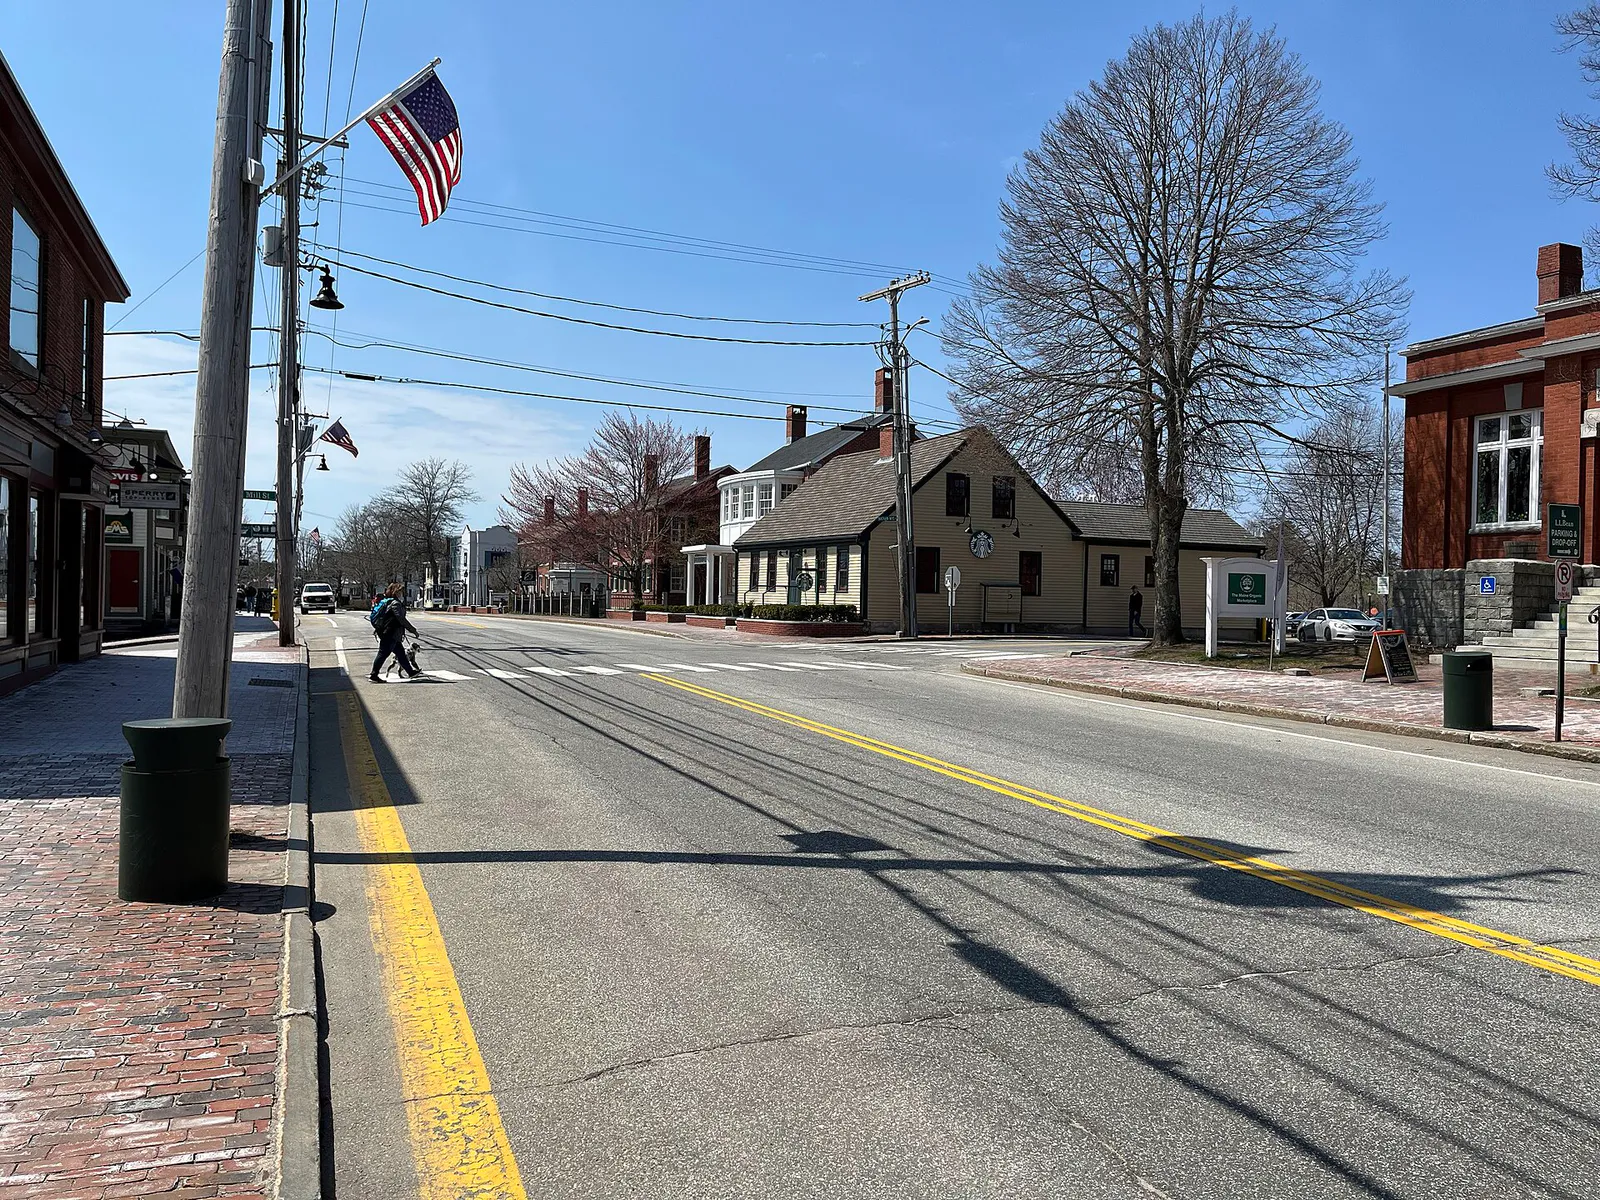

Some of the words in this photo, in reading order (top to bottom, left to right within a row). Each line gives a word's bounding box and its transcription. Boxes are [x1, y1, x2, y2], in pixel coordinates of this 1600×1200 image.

[124, 489, 165, 497] SPERRY
[245, 491, 261, 499] Mill
[104, 525, 129, 534] EMS
[1551, 529, 1573, 538] PARKING
[1552, 538, 1577, 547] DROP-OFF
